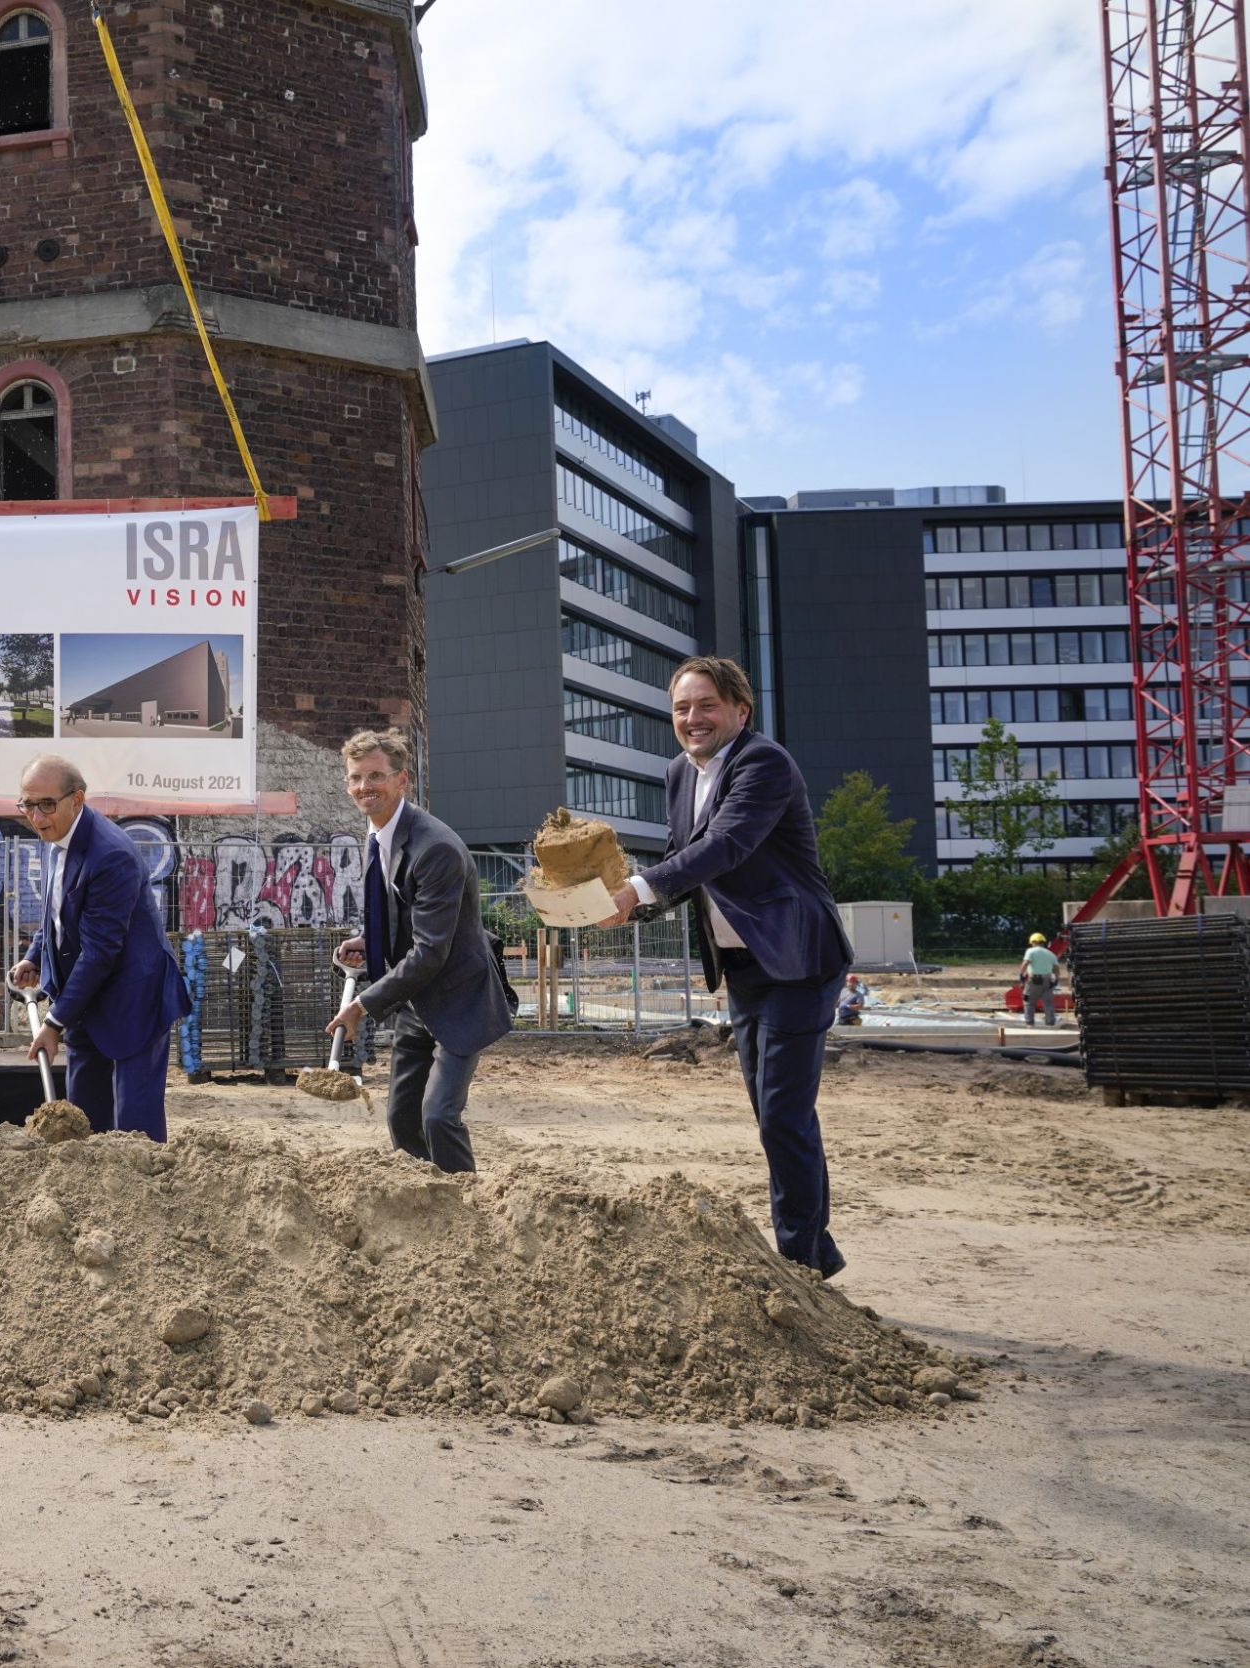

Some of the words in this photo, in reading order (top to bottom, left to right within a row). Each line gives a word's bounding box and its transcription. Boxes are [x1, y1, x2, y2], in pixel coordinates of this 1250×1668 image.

[126, 520, 245, 581] ISRA
[127, 588, 246, 607] VISION
[127, 773, 148, 787] 10.
[152, 774, 205, 792] August
[208, 775, 241, 790] 2021
